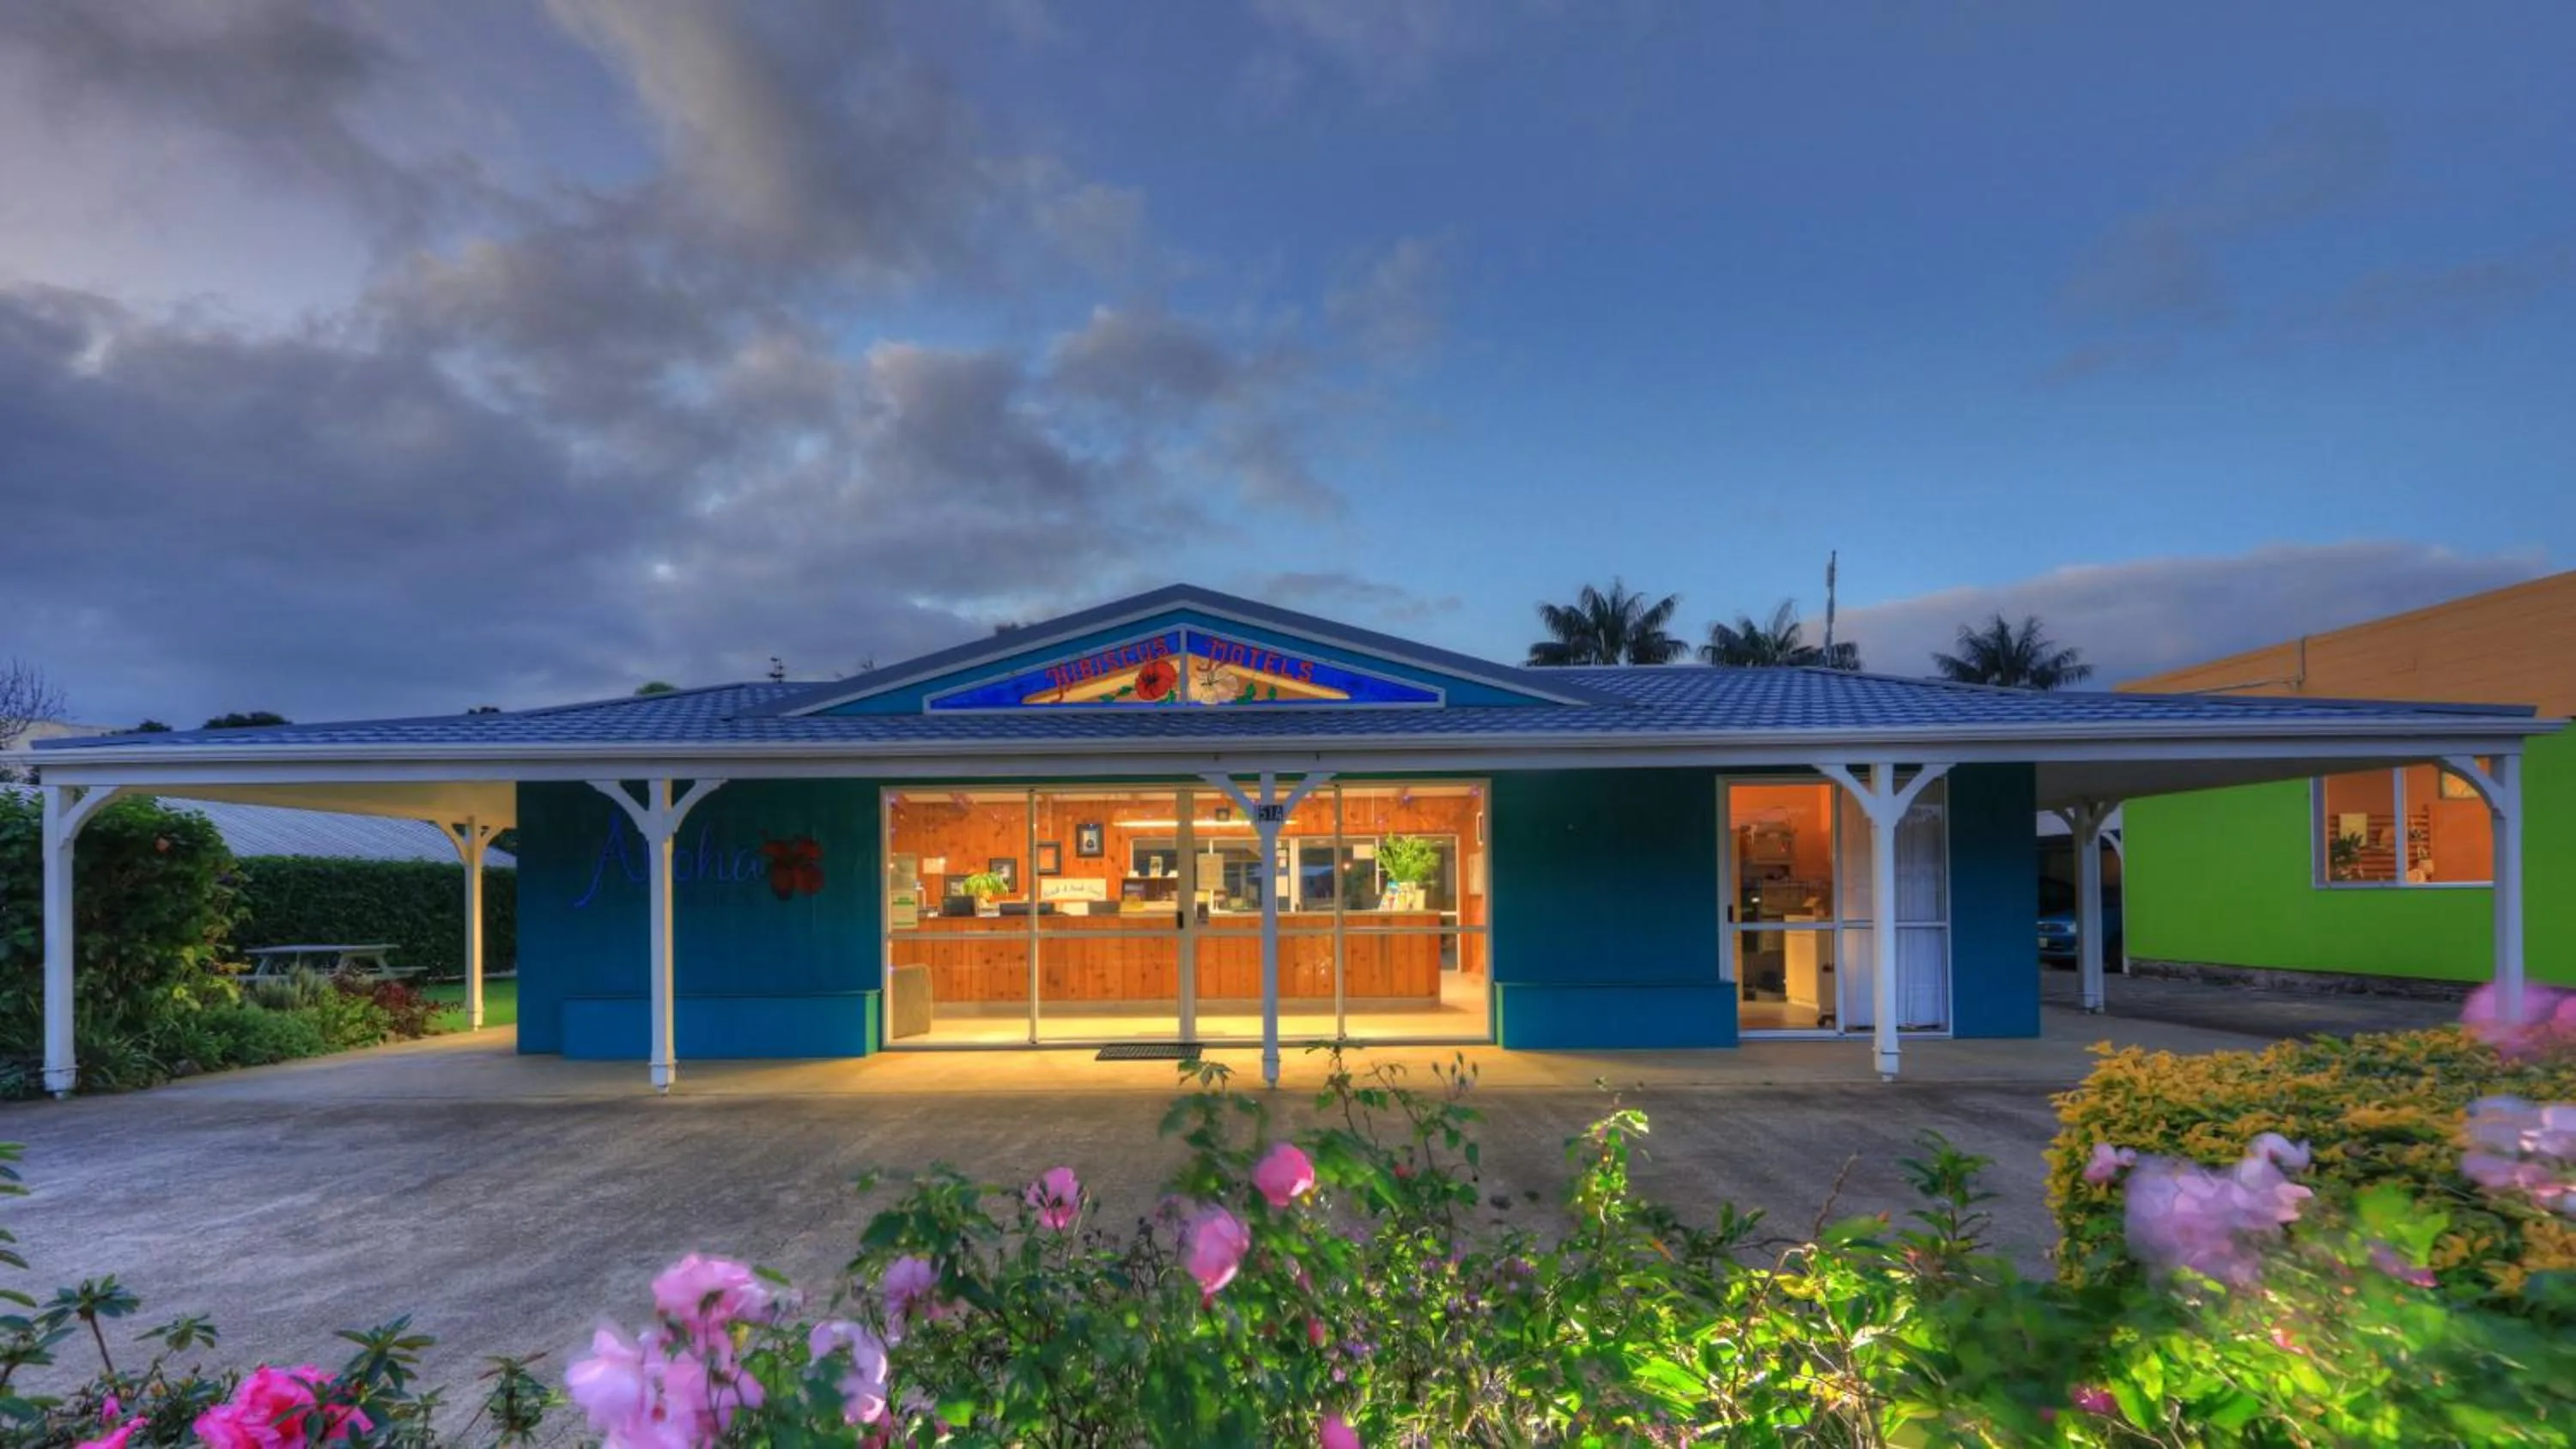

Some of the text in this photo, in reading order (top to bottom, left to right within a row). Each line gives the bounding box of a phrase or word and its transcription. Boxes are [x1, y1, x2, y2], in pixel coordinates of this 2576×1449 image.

[1045, 636, 1314, 701] HIBISCUS MOTELS
[573, 808, 762, 907] Aoha
